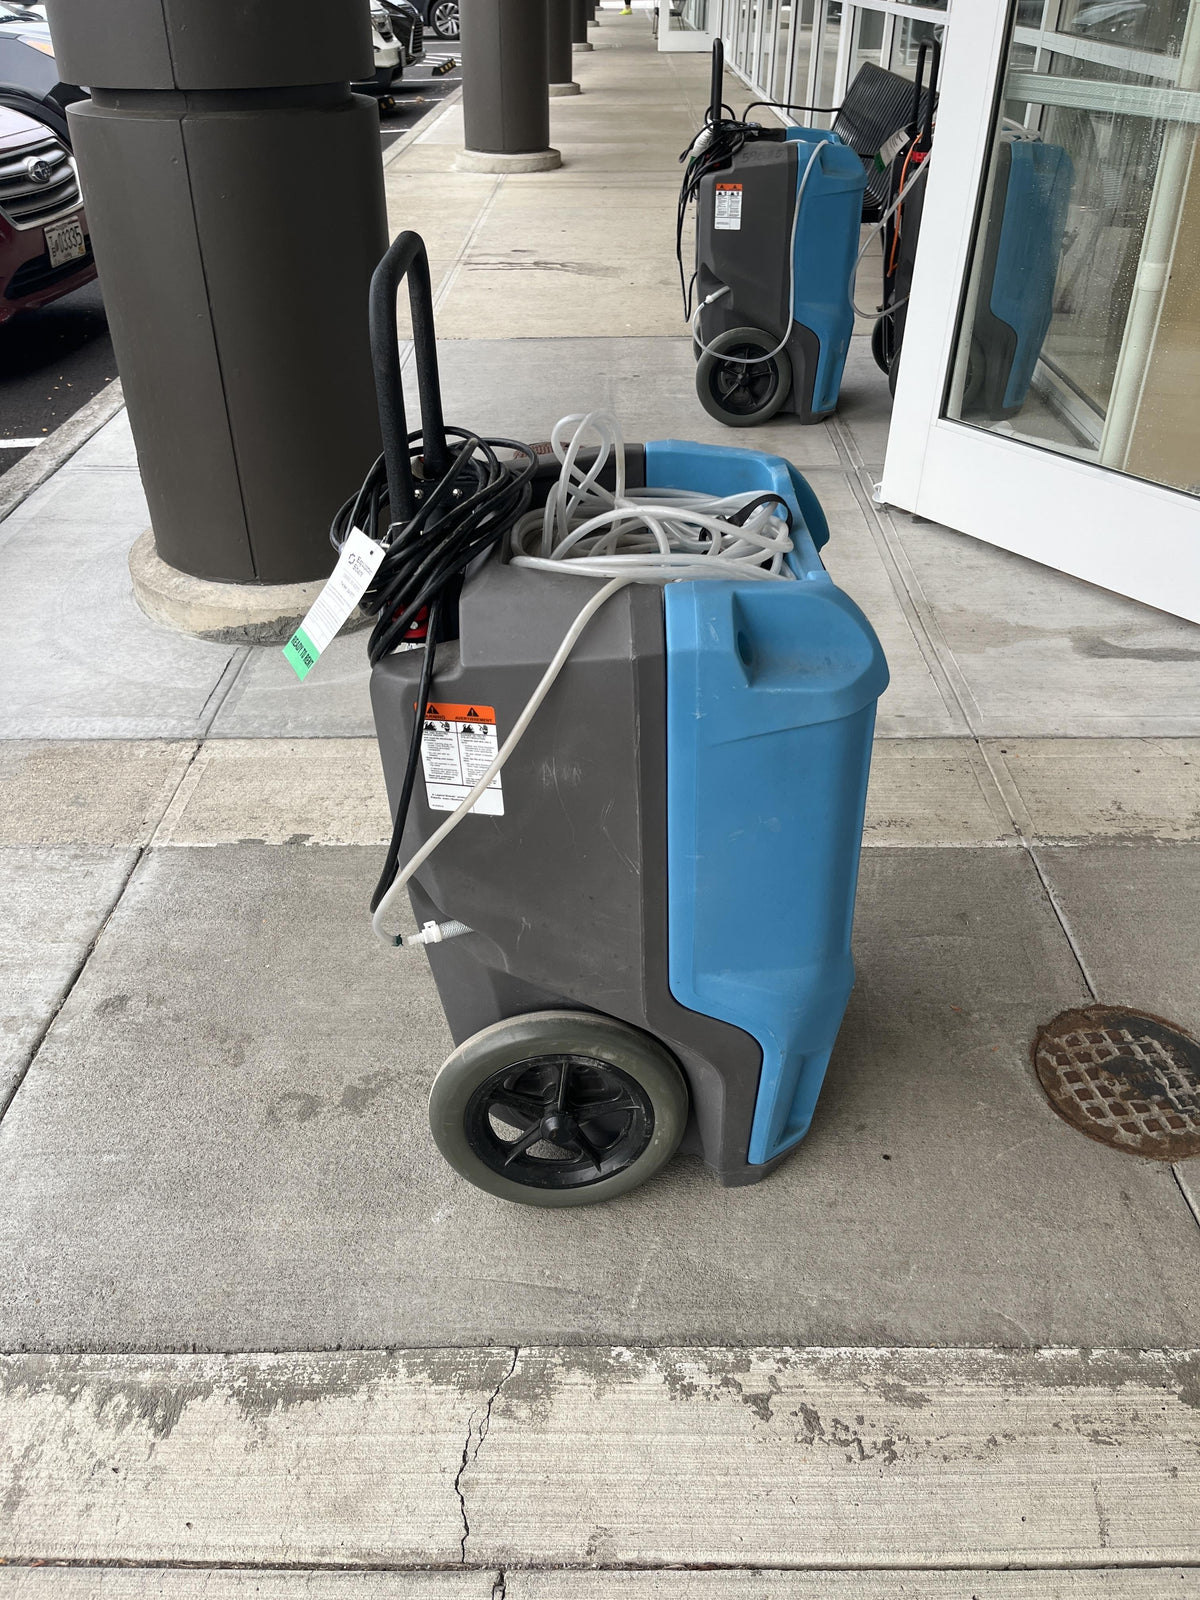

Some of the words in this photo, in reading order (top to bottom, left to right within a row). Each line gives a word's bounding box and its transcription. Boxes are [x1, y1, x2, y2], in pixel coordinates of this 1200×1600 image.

[290, 635, 304, 653] READY
[300, 648, 308, 659] TO
[303, 653, 314, 669] RENT
